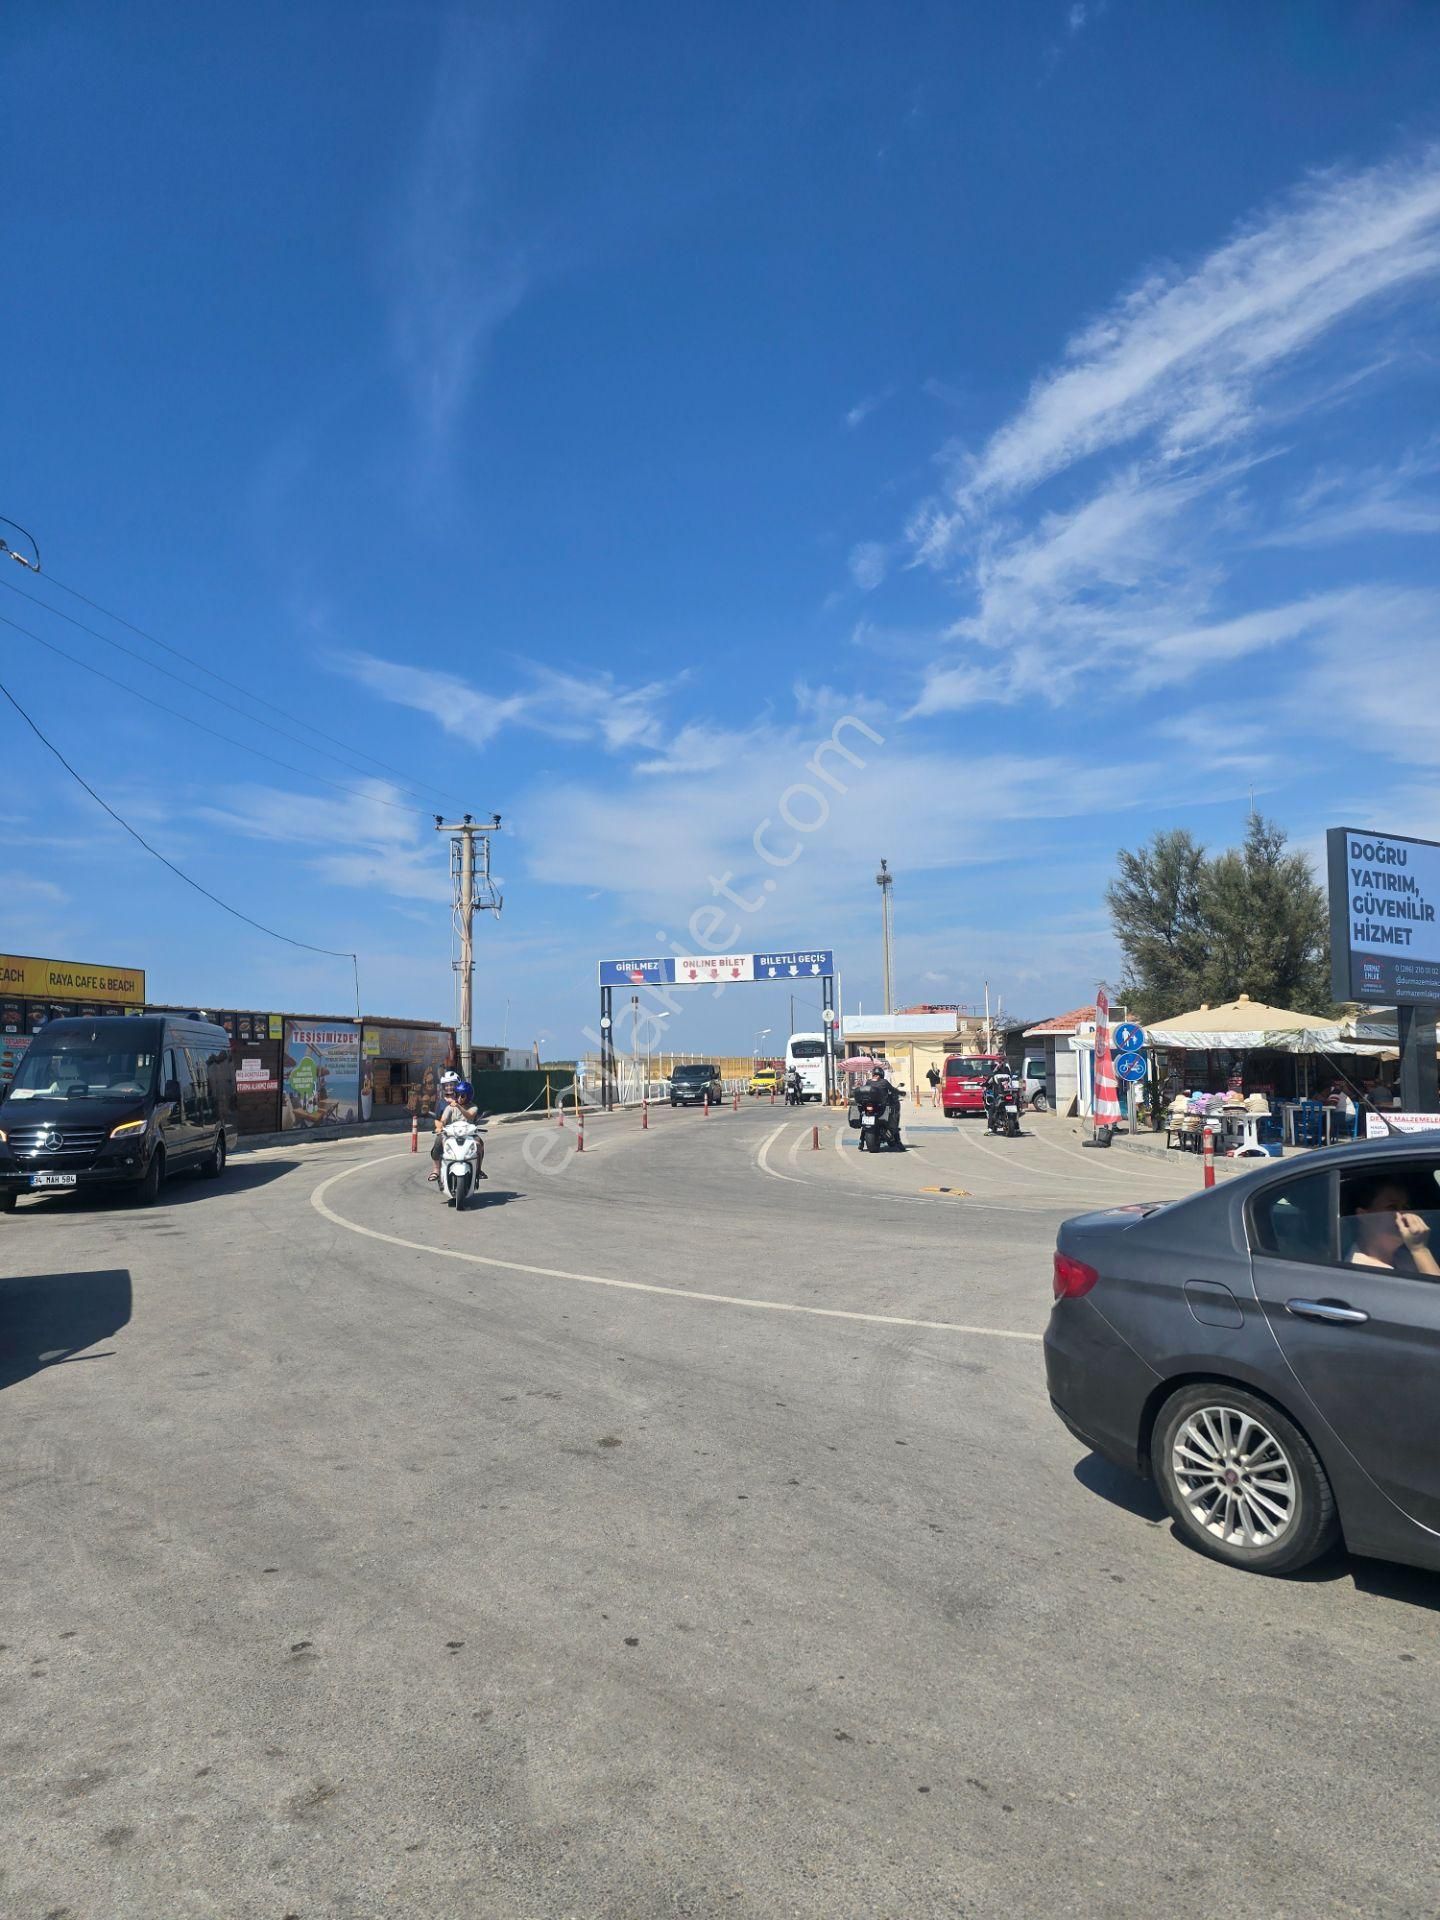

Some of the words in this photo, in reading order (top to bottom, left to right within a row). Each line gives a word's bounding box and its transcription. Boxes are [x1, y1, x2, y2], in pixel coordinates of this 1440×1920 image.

[1351, 841, 1407, 866] DOĞRU
[1351, 869, 1419, 898] YATIRIM,
[1352, 892, 1435, 922] GÜVENİLİR
[1353, 918, 1412, 945] HİZMET
[616, 962, 659, 971] GİRİLMEZ
[719, 958, 746, 967] BİLET
[760, 954, 796, 966] BİLETLİ
[49, 972, 74, 987] RAYA
[75, 976, 98, 989] CAFE
[99, 978, 106, 990] &
[107, 979, 135, 992] BEACH
